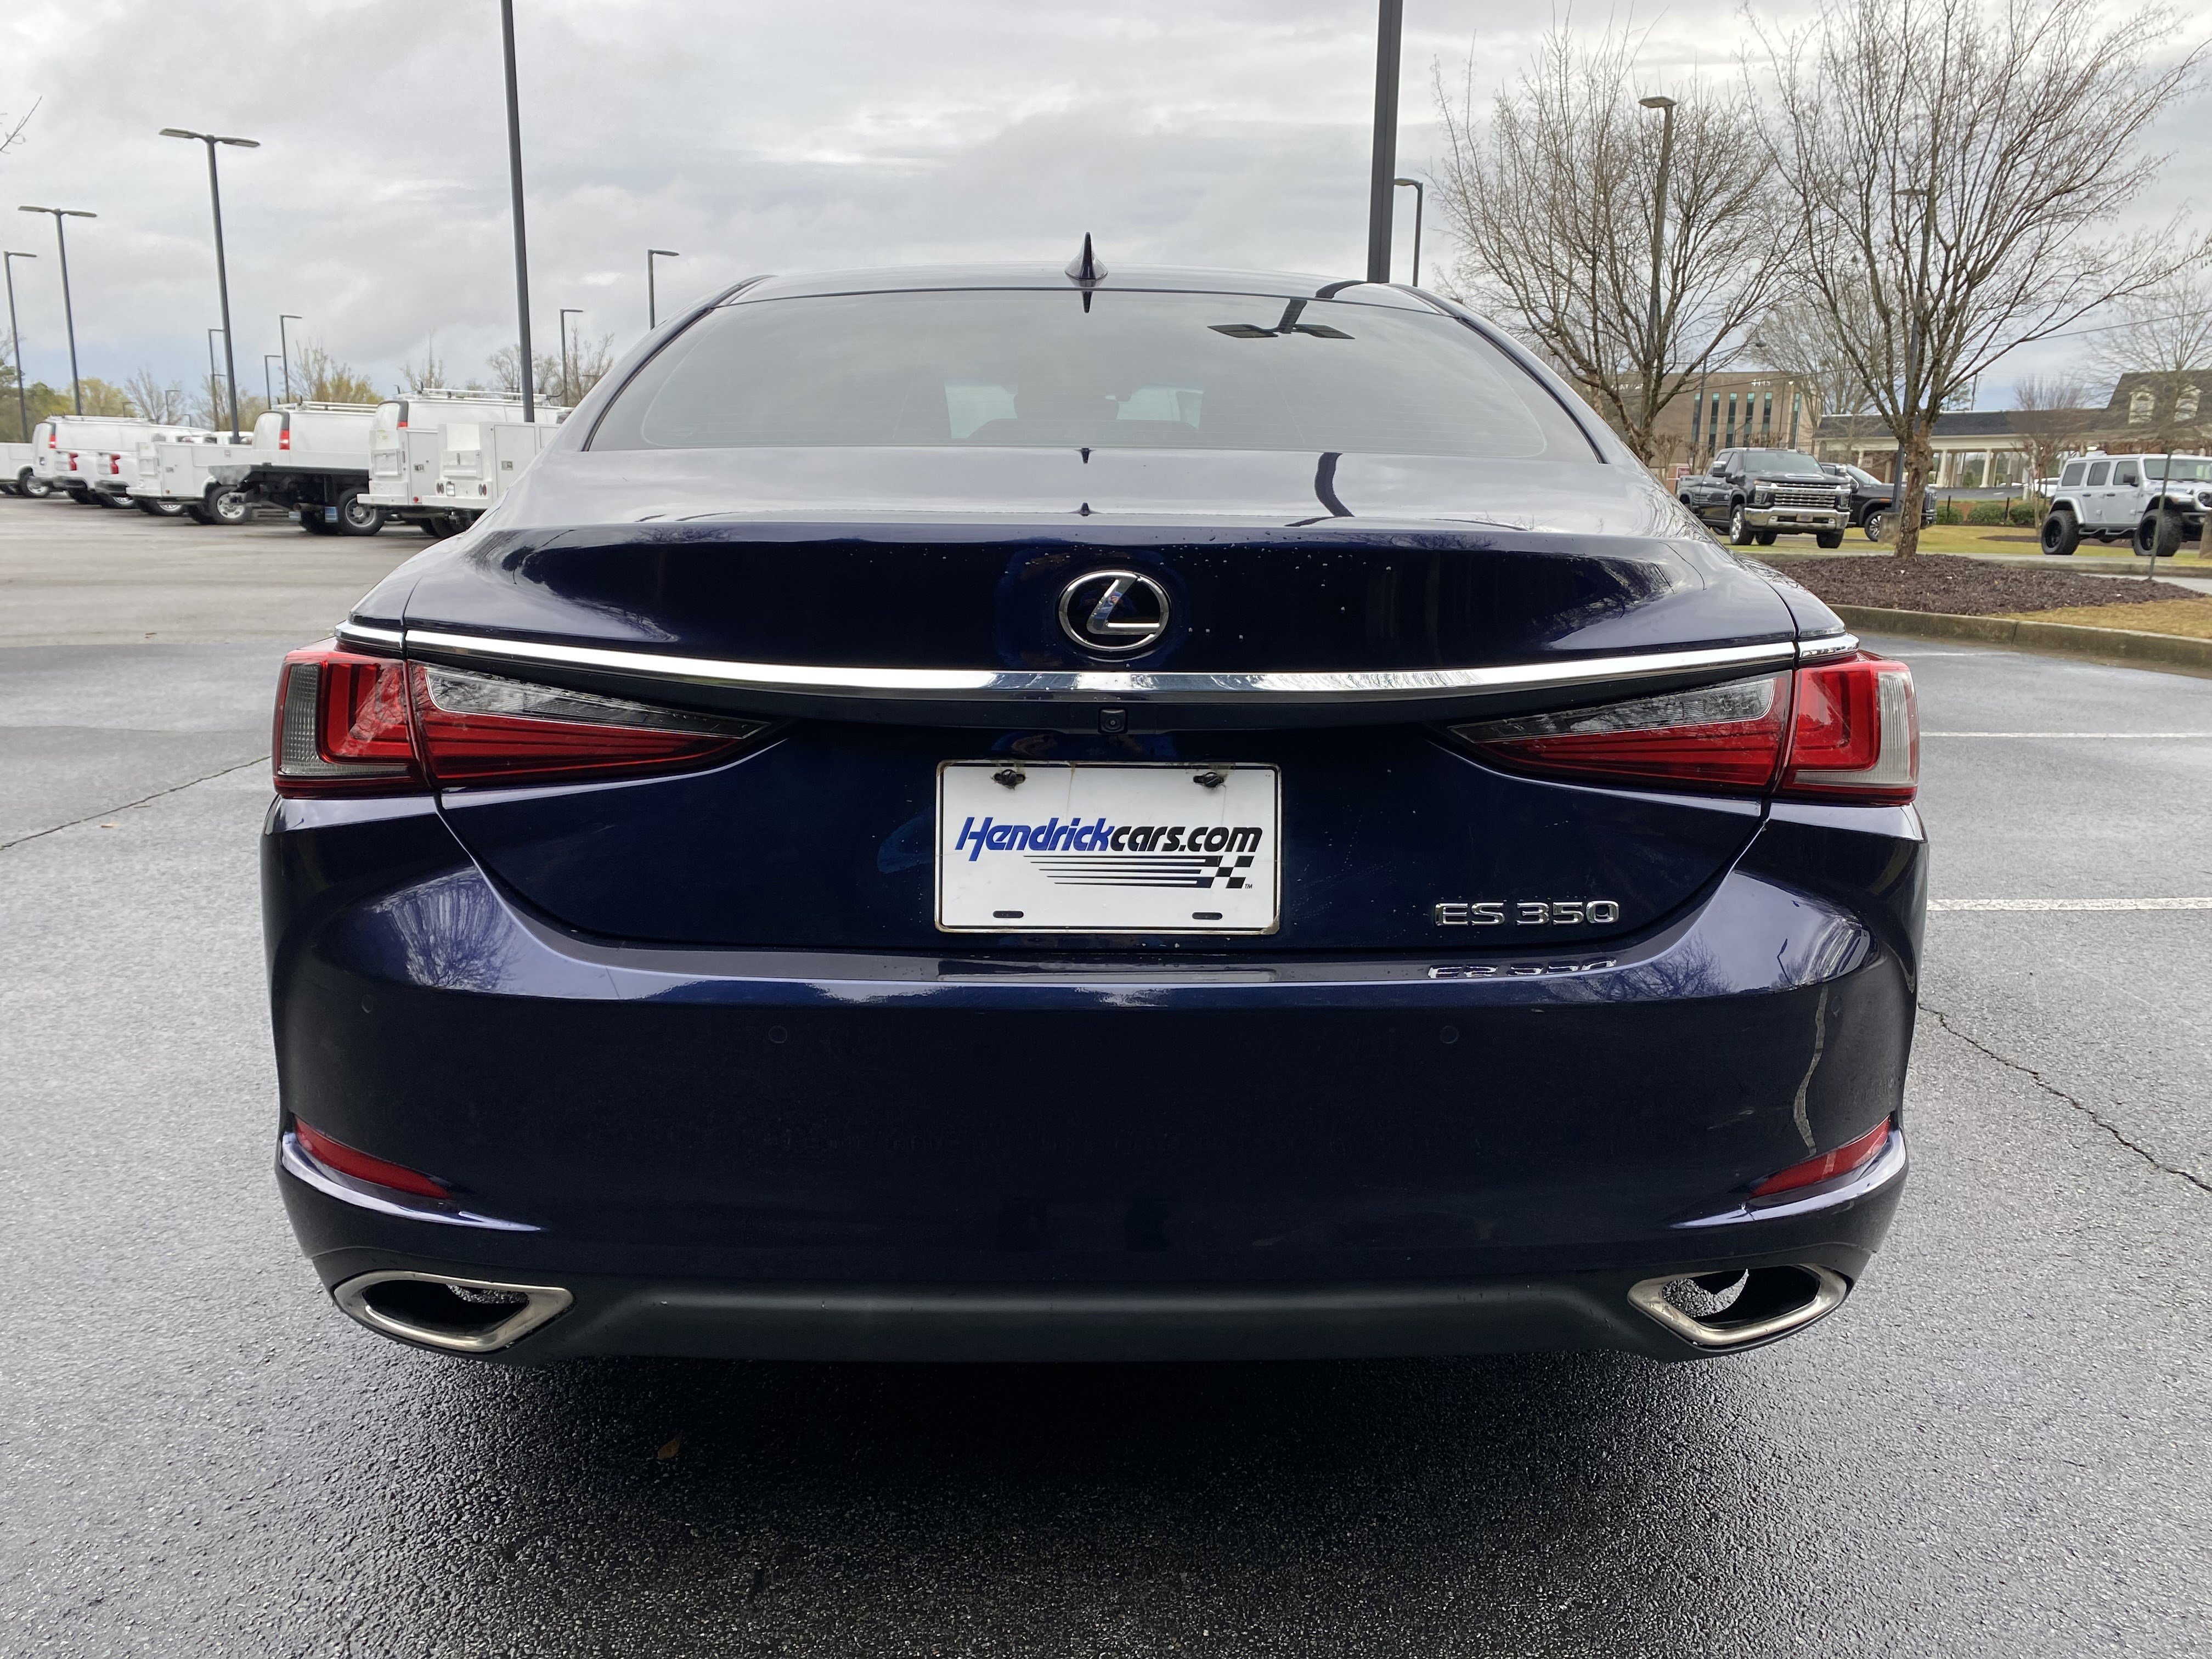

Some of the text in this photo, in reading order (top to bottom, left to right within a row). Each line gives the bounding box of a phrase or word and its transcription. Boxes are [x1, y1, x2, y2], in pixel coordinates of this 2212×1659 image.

[955, 817, 1262, 861] Hendrickcars.com
[1435, 900, 1619, 926] ES 350
